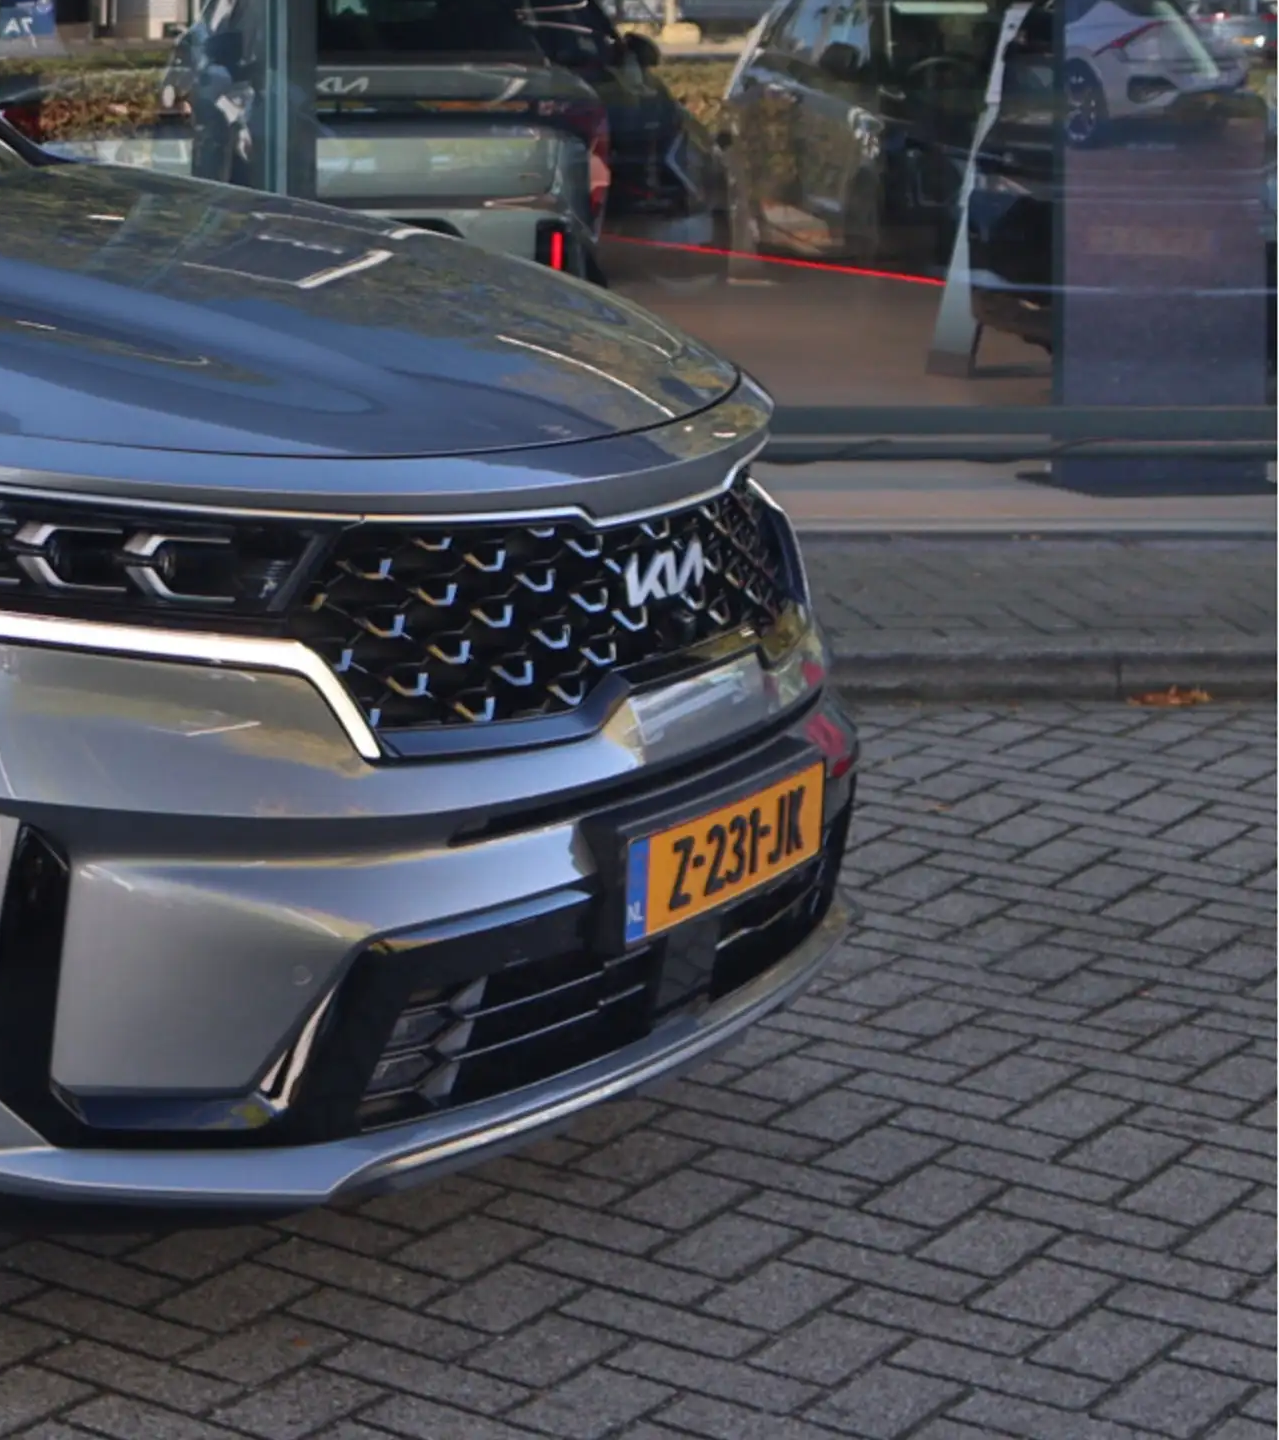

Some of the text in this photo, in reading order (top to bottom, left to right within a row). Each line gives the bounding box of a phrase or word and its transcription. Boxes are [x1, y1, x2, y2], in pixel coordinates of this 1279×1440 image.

[625, 537, 704, 608] KIA
[668, 784, 806, 912] Z-231-JK
[626, 902, 644, 925] NL
